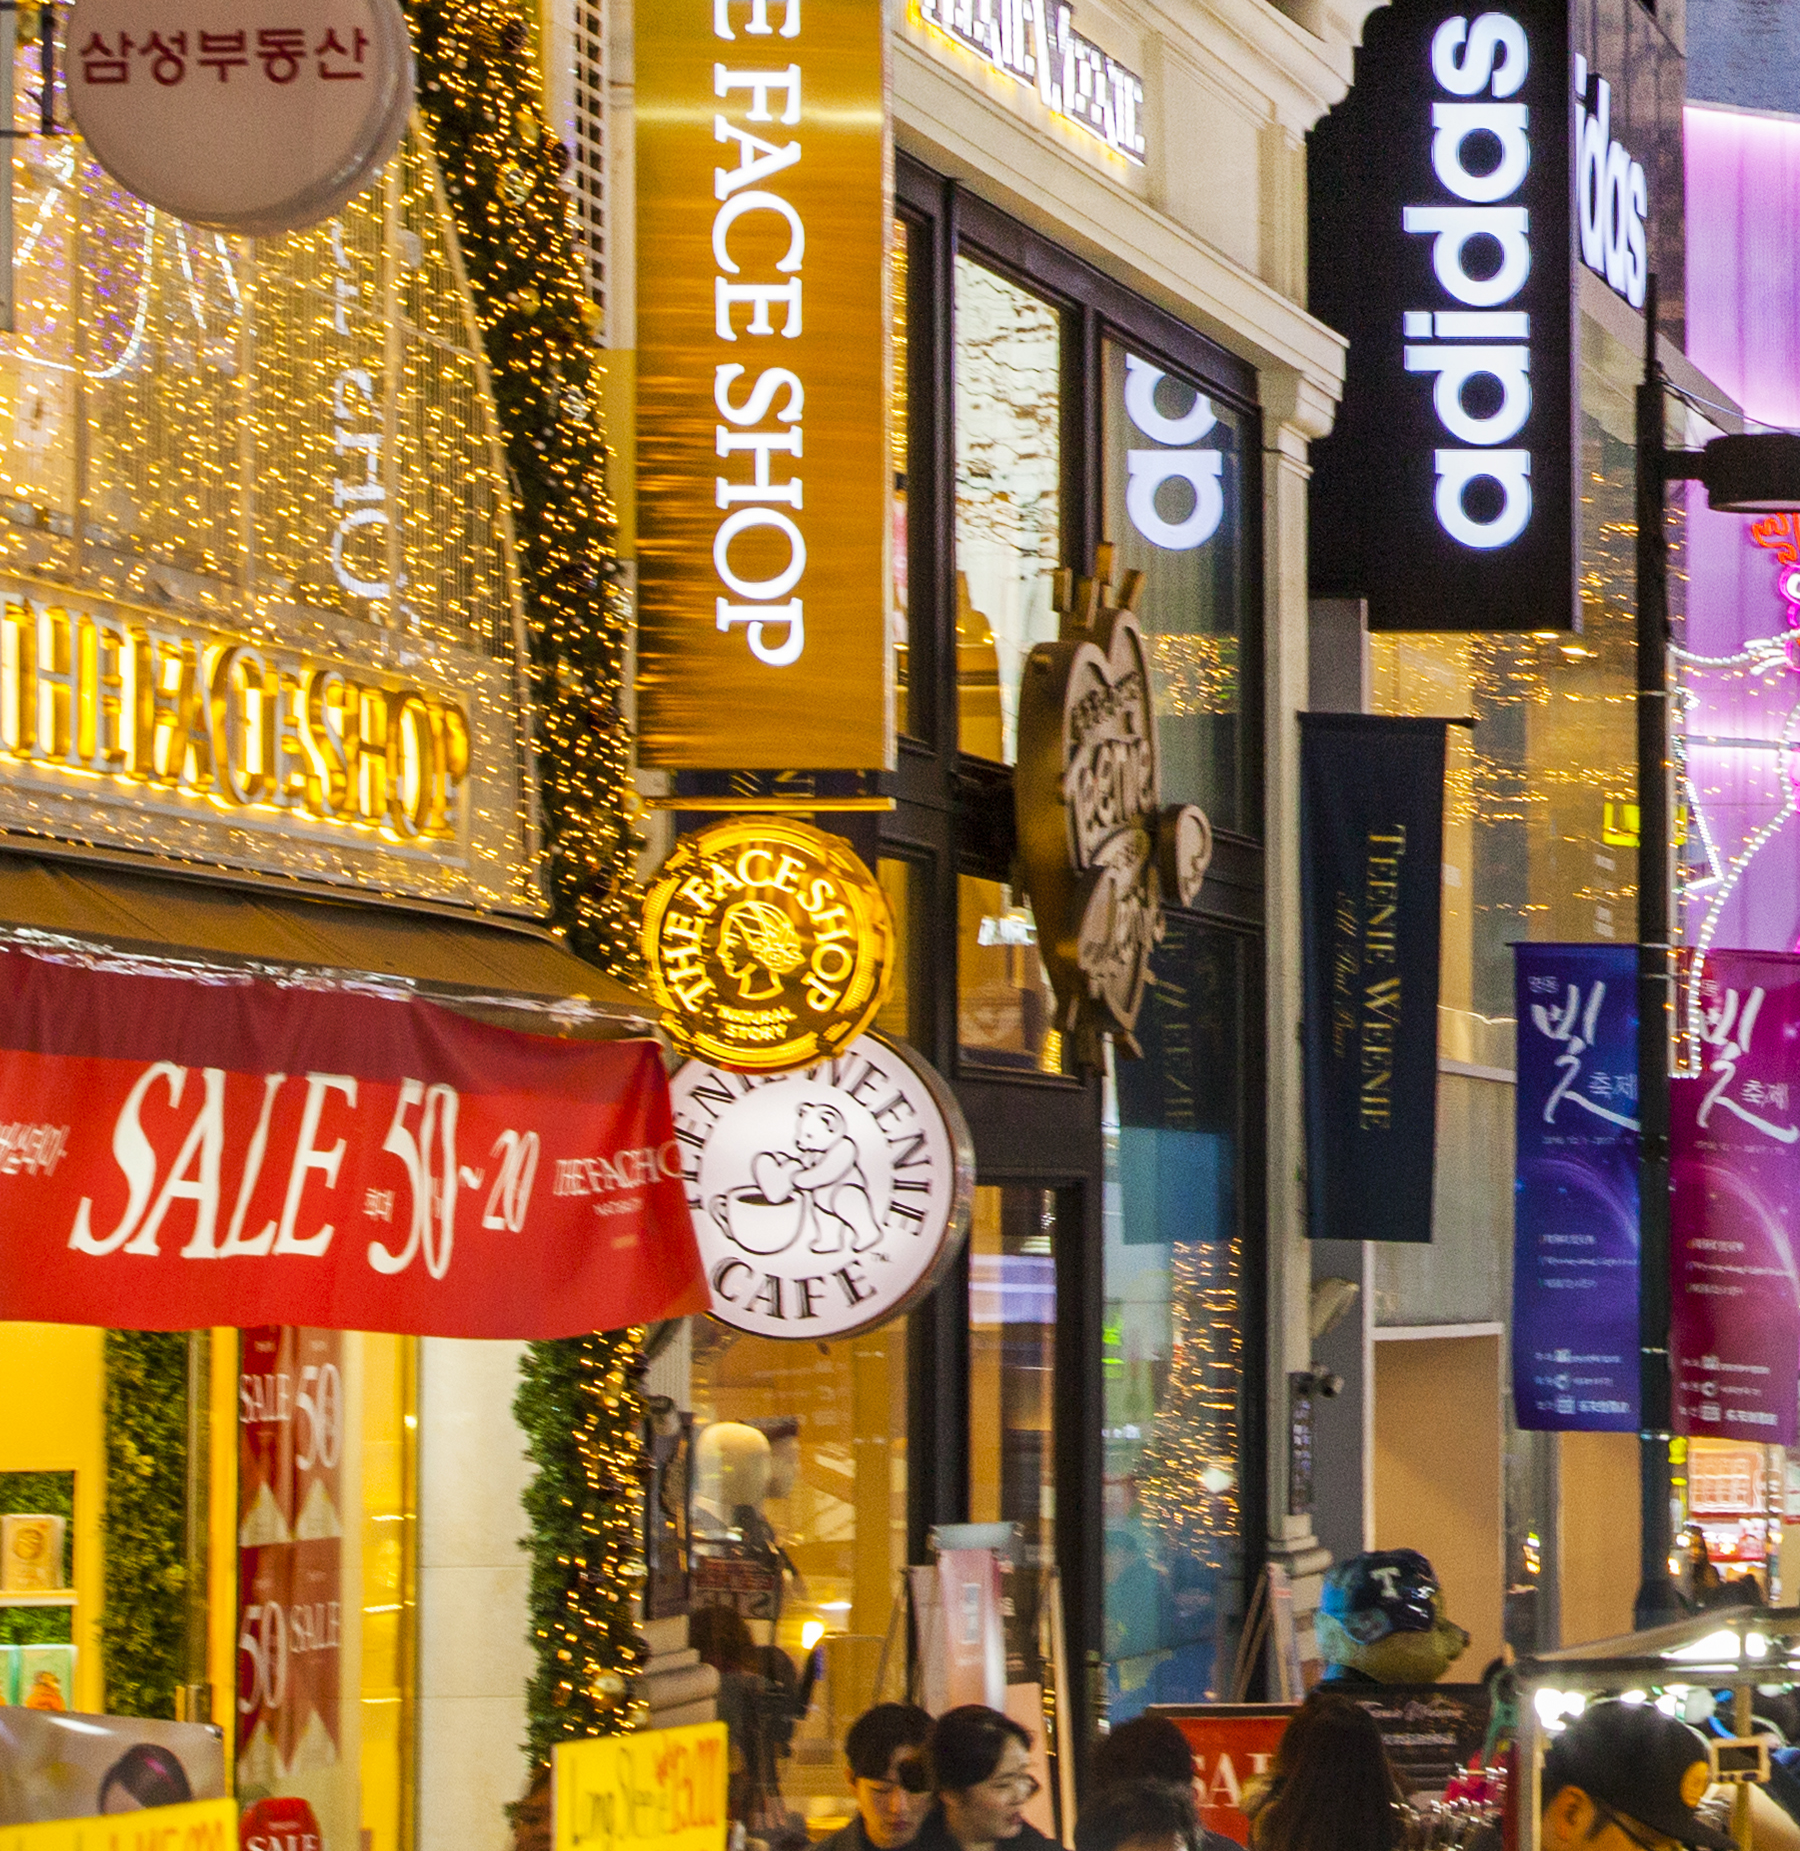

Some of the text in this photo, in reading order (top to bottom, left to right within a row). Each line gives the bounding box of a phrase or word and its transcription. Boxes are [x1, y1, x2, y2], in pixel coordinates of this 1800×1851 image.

[78, 27, 370, 87] 삼성부동산
[711, 62, 806, 341] FACE
[1404, 12, 1533, 550] adidas
[711, 362, 807, 668] SHOP
[66, 1060, 358, 1259] SALE
[711, 1255, 878, 1321] CAFE
